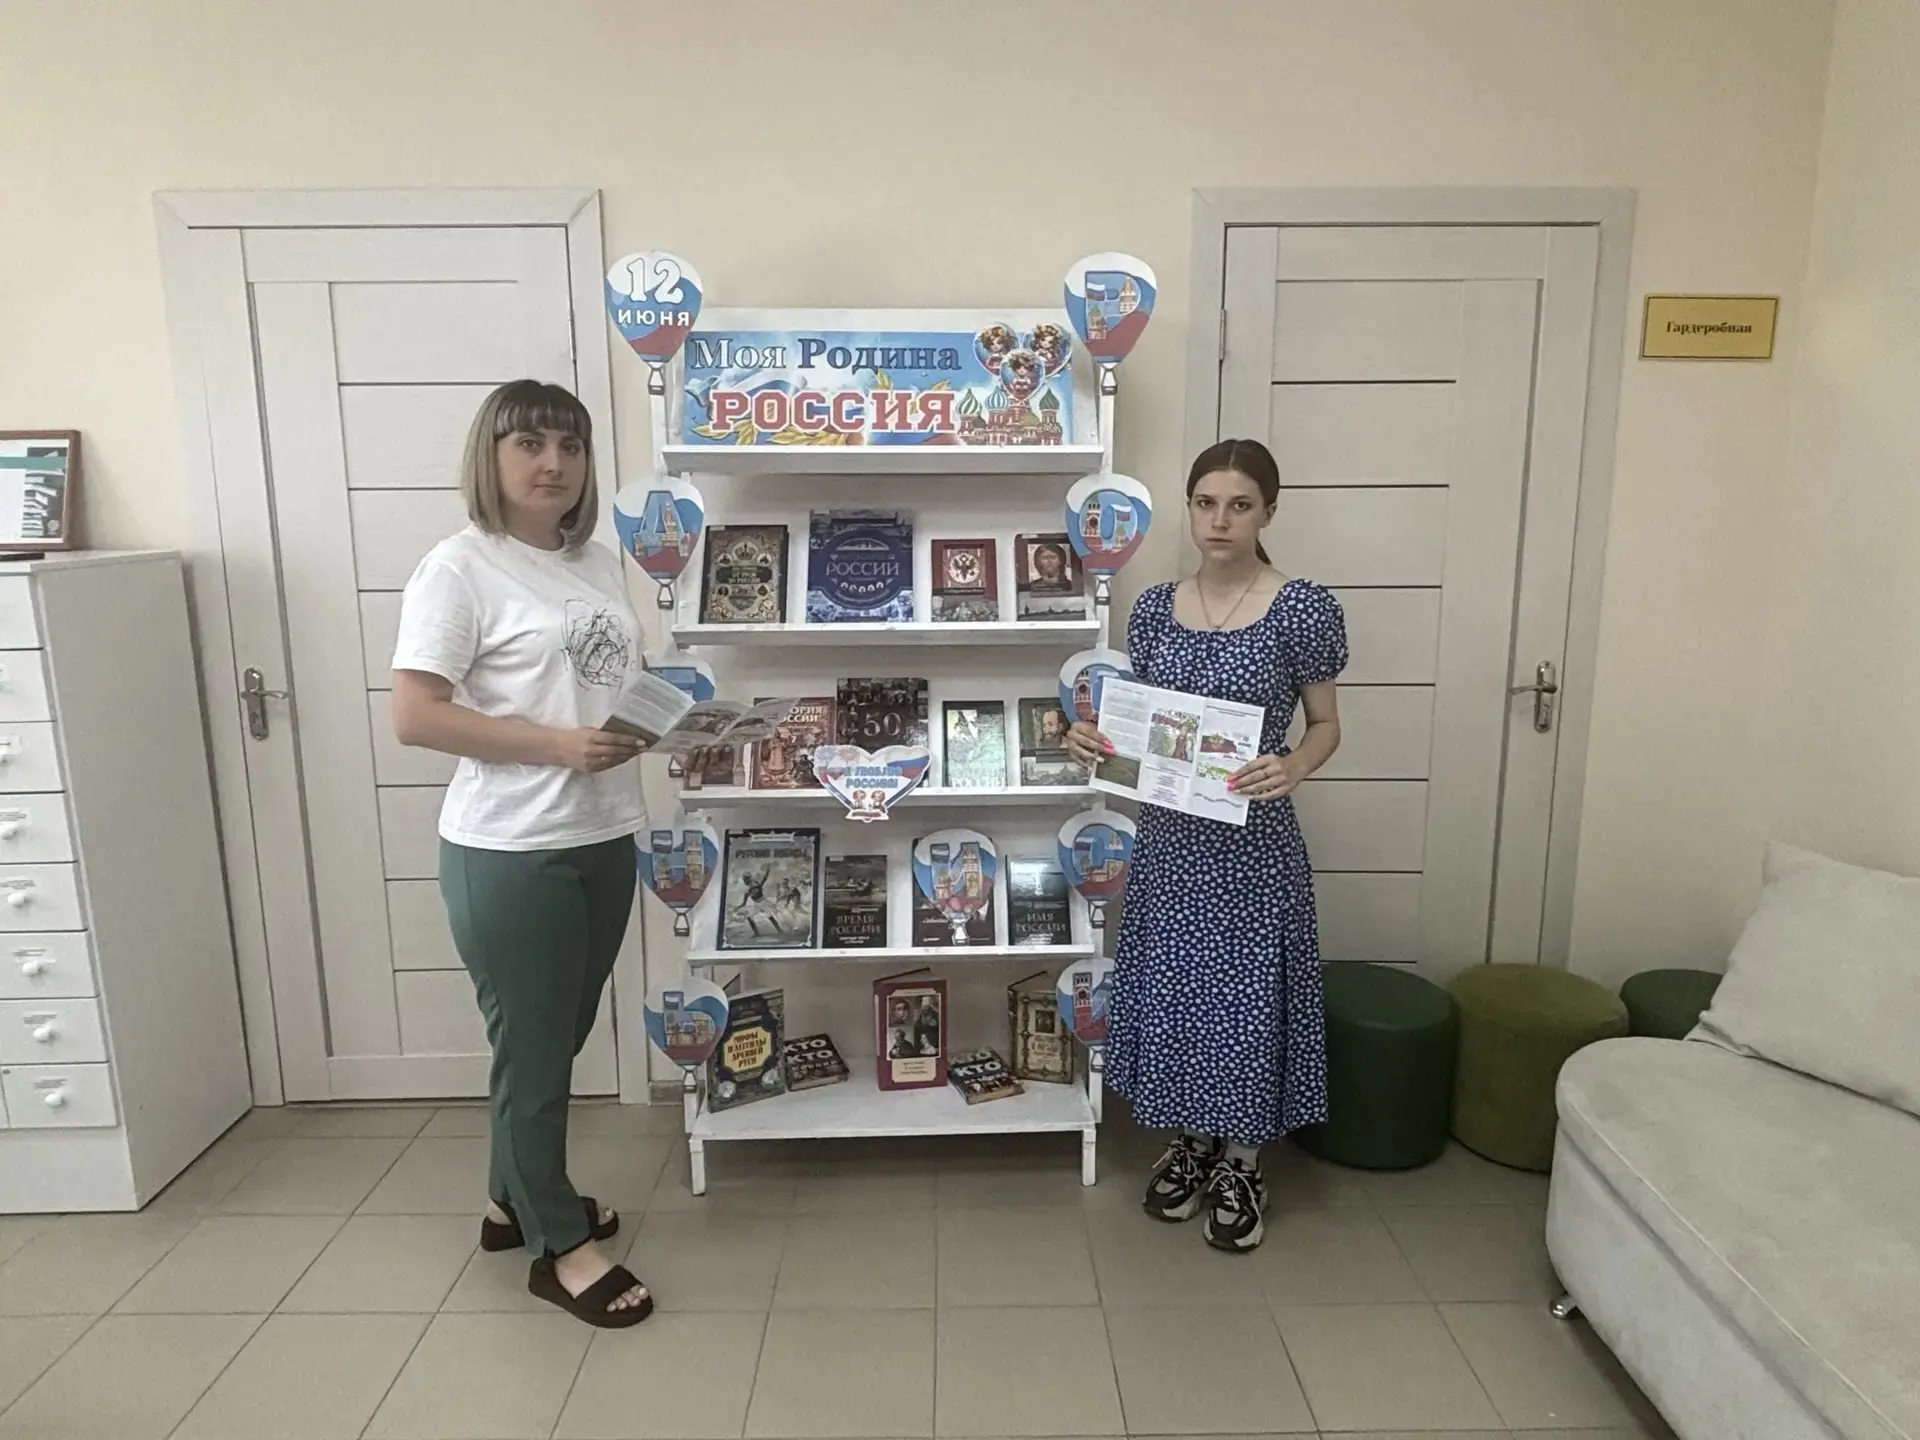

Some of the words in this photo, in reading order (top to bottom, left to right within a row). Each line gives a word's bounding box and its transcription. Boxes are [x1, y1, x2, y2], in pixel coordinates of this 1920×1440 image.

[626, 257, 684, 304] 12
[617, 308, 690, 327] ИЮНЯ
[1666, 321, 1752, 335] Гардеробная
[691, 338, 787, 370] Моя
[797, 338, 962, 375] Родина
[710, 390, 956, 432] РОССИЯ
[826, 562, 900, 576] РОССИИ
[863, 712, 901, 737] 50
[836, 914, 875, 925] ВРЕМЯ
[1027, 912, 1055, 922] ИМЯ
[829, 924, 881, 935] РОССИИ
[1015, 922, 1067, 933] РОССИИ
[787, 1050, 833, 1065] КТО
[955, 1061, 1002, 1077] КТО
